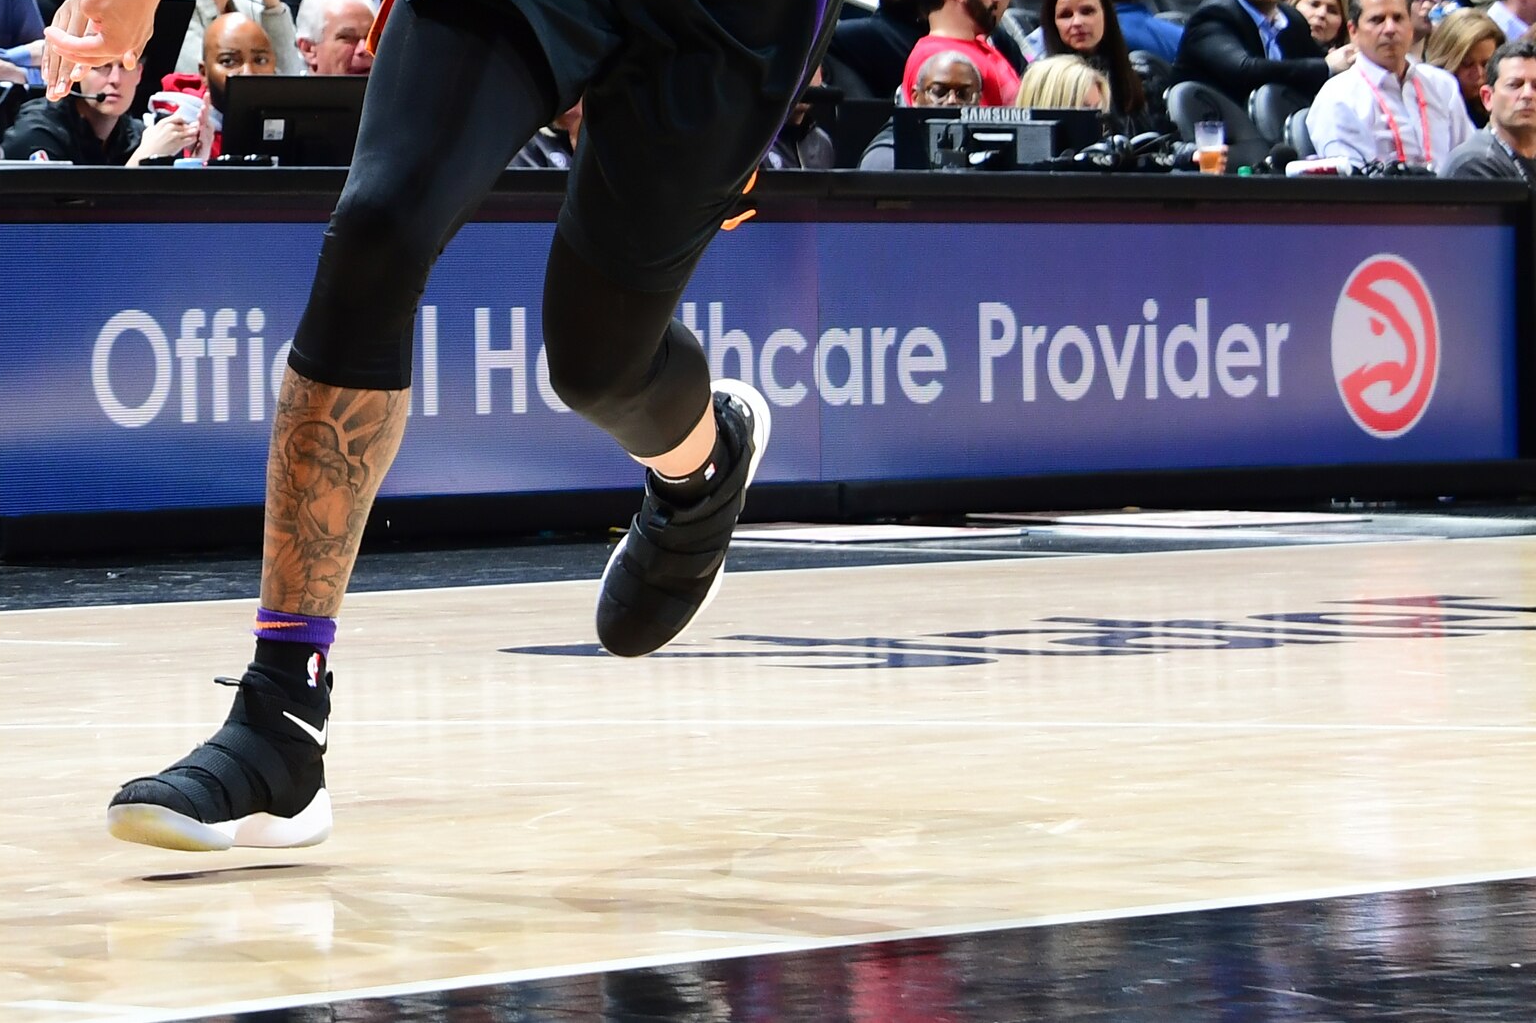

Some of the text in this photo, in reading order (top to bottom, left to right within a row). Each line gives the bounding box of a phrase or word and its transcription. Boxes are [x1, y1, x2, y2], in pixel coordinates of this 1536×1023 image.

[960, 107, 1031, 122] SAMSUNG
[92, 298, 1290, 427] Offil Hhcare Provider
